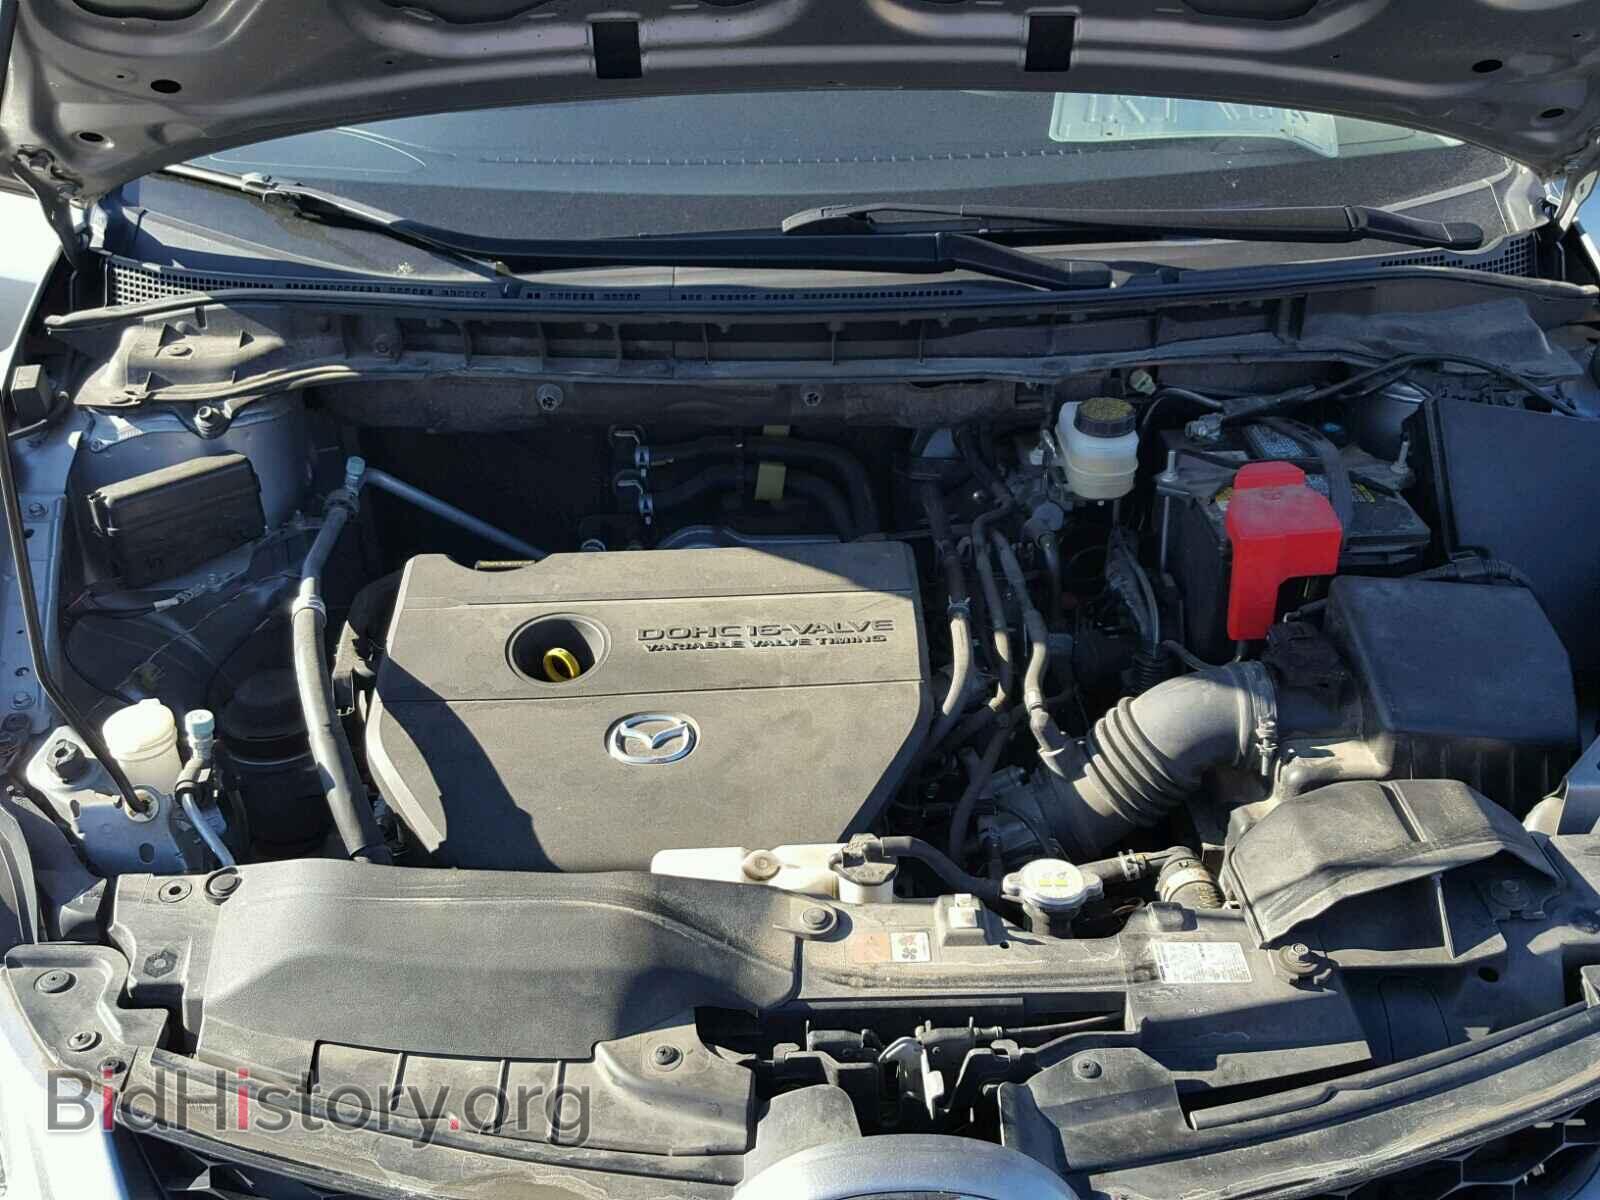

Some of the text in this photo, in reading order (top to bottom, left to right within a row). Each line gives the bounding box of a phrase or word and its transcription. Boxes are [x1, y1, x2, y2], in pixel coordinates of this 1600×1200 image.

[638, 619, 895, 641] DOHC 16-VALVE
[645, 634, 888, 652] VARIABLE VALVE TIMING
